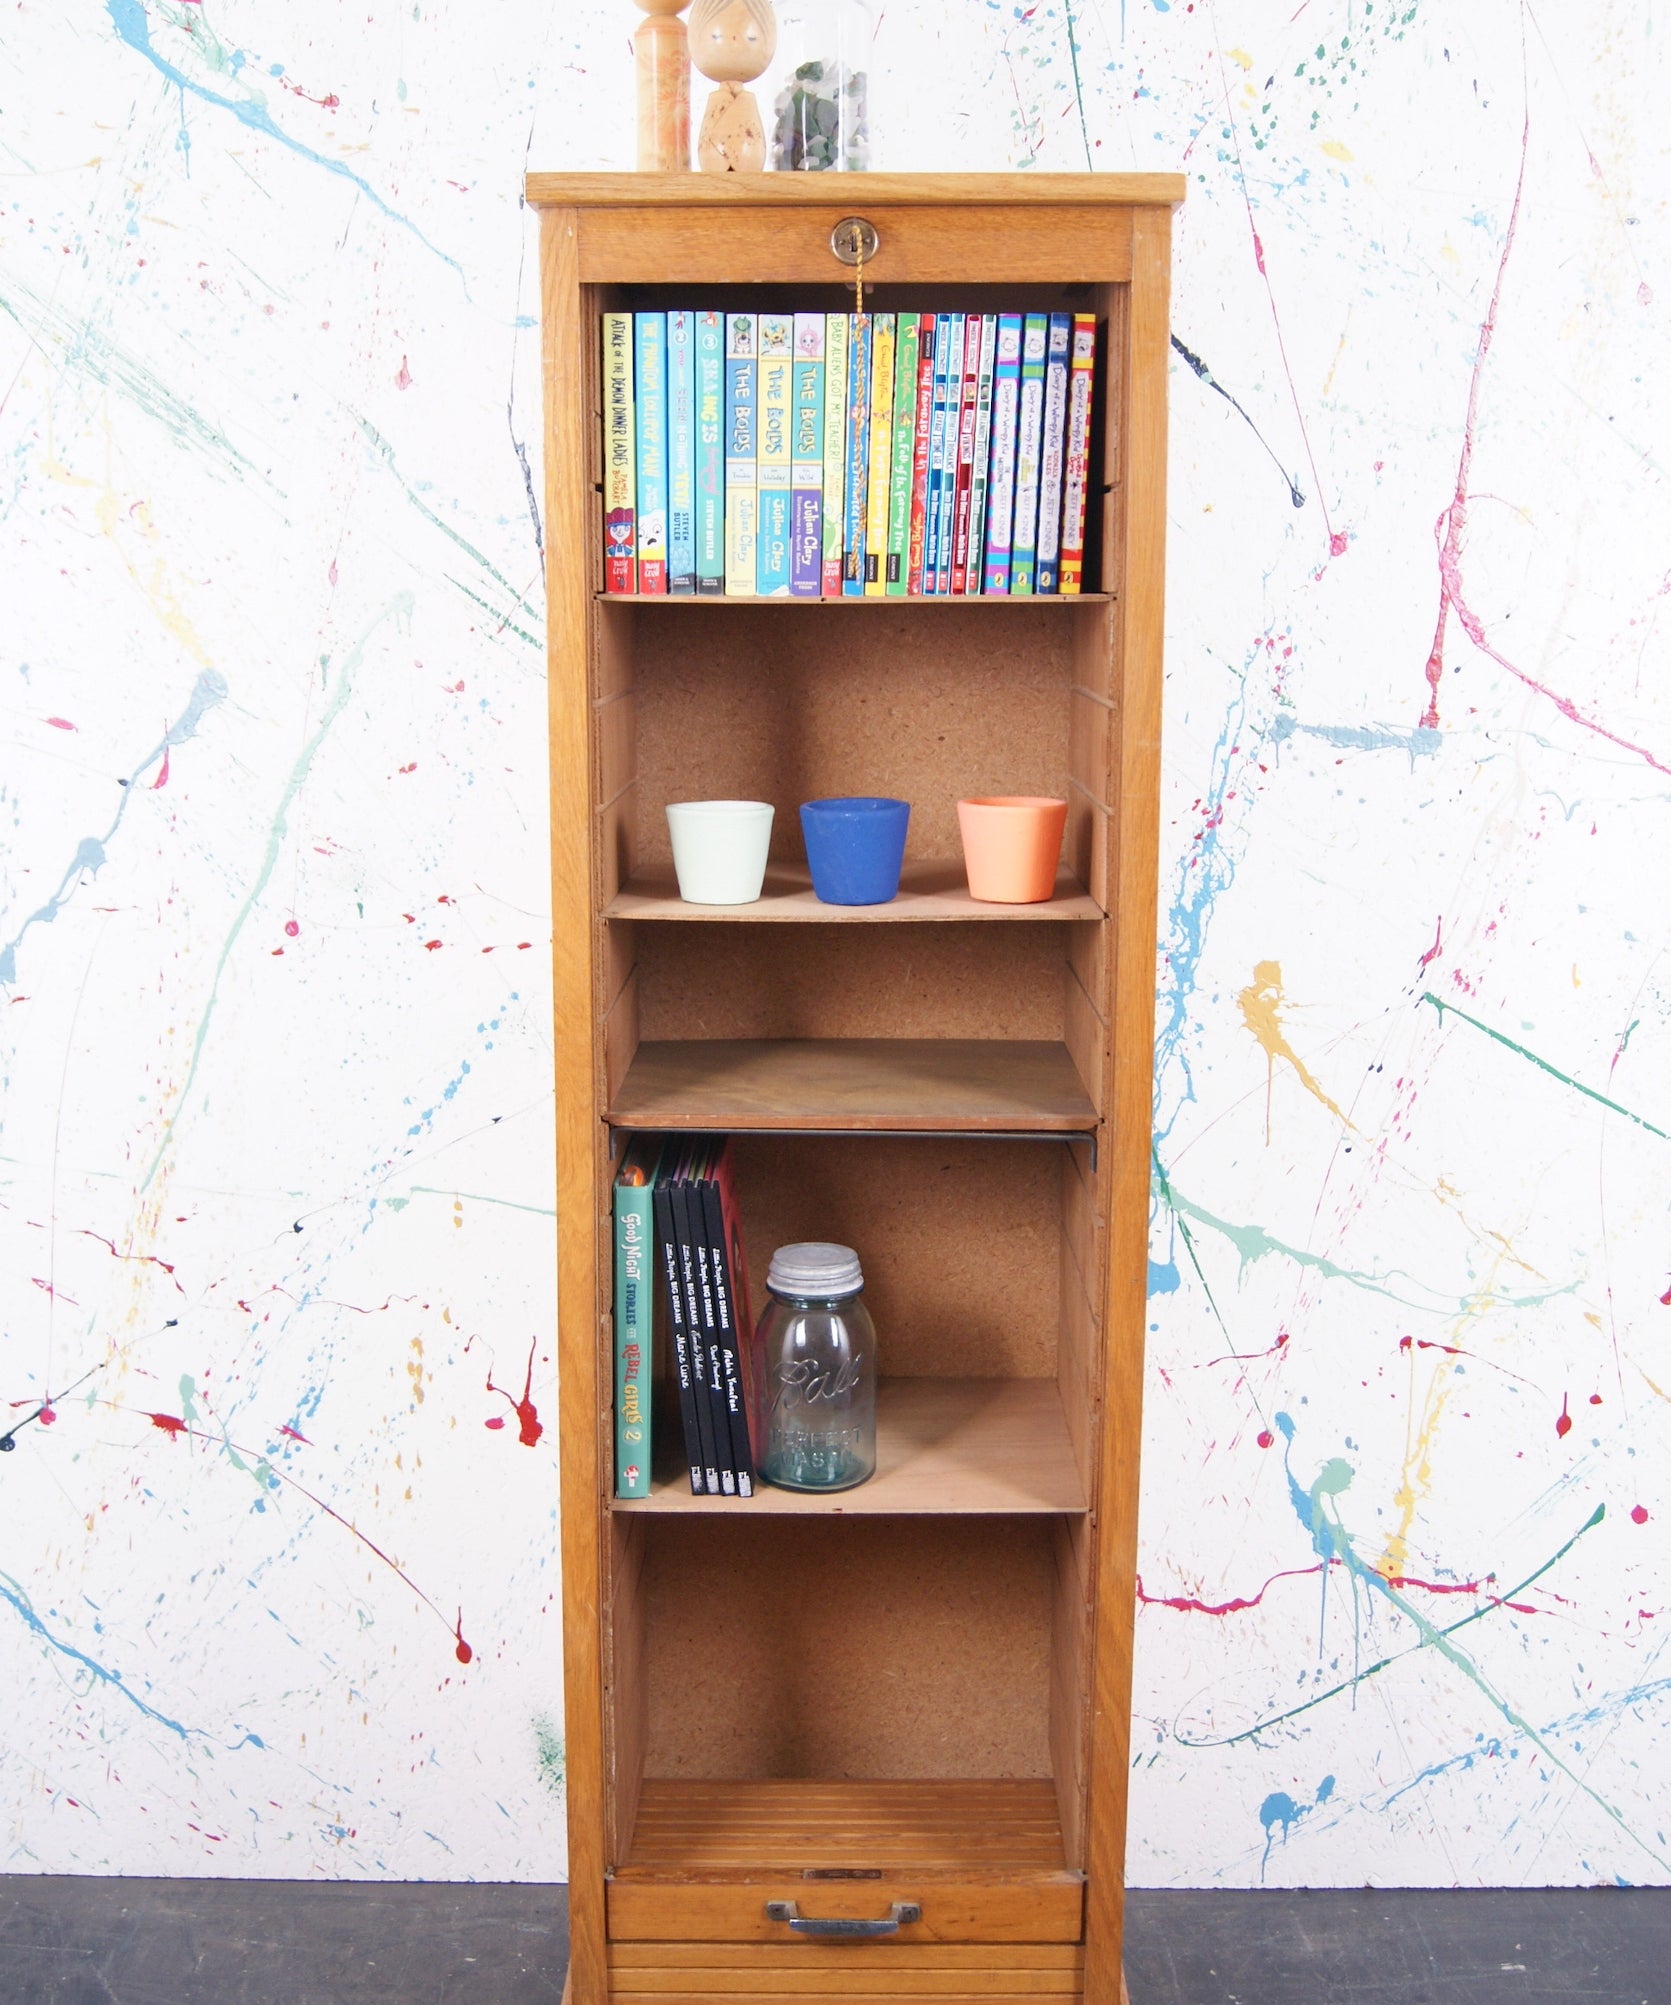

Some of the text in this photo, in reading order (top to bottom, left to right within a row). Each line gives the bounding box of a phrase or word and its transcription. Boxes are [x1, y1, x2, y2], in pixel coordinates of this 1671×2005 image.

[612, 319, 626, 348] ATTACK
[831, 321, 844, 343] BABY
[614, 362, 624, 373] THE
[831, 347, 842, 375] ALIENS
[768, 366, 784, 400] THE
[831, 379, 842, 398] GOT
[921, 366, 931, 386] Tree
[1053, 367, 1063, 391] Diary
[1076, 378, 1085, 400] Diary
[611, 377, 626, 404] DEMON
[612, 408, 627, 435] DINNER
[733, 364, 752, 453] THE BOLDS
[798, 367, 817, 454] THE BOLDS
[918, 391, 930, 437] Faraway
[1049, 407, 1060, 433] Wimpy
[702, 424, 718, 443] IS
[766, 408, 784, 455] BOLDS
[1073, 415, 1082, 439] Wimpy
[612, 439, 629, 466] LADIES
[1049, 435, 1060, 448] Kid
[1073, 440, 1084, 453] Kid
[803, 500, 819, 534] Julian
[894, 490, 906, 529] Faraway
[673, 512, 681, 541] BUTLER
[706, 499, 714, 560] STEVEN BUTLER
[1044, 521, 1053, 555] KINNEY
[1067, 515, 1077, 545] KINNEY
[737, 534, 753, 563] Clary
[802, 536, 818, 566] Clary
[894, 531, 904, 552] Tree
[620, 1214, 642, 1243] GOOD
[621, 1244, 642, 1280] NIGHT
[626, 1283, 636, 1325] STORIES
[673, 1295, 682, 1323] DREAMS
[688, 1297, 698, 1325] DREAMS
[704, 1299, 714, 1327] DREAMS
[719, 1300, 729, 1329] DREAMS
[676, 1334, 686, 1363] Marie
[621, 1344, 641, 1382] REBEL
[680, 1365, 689, 1388] Curie
[621, 1385, 643, 1424] GIRLS
[625, 1430, 641, 1440] 2
